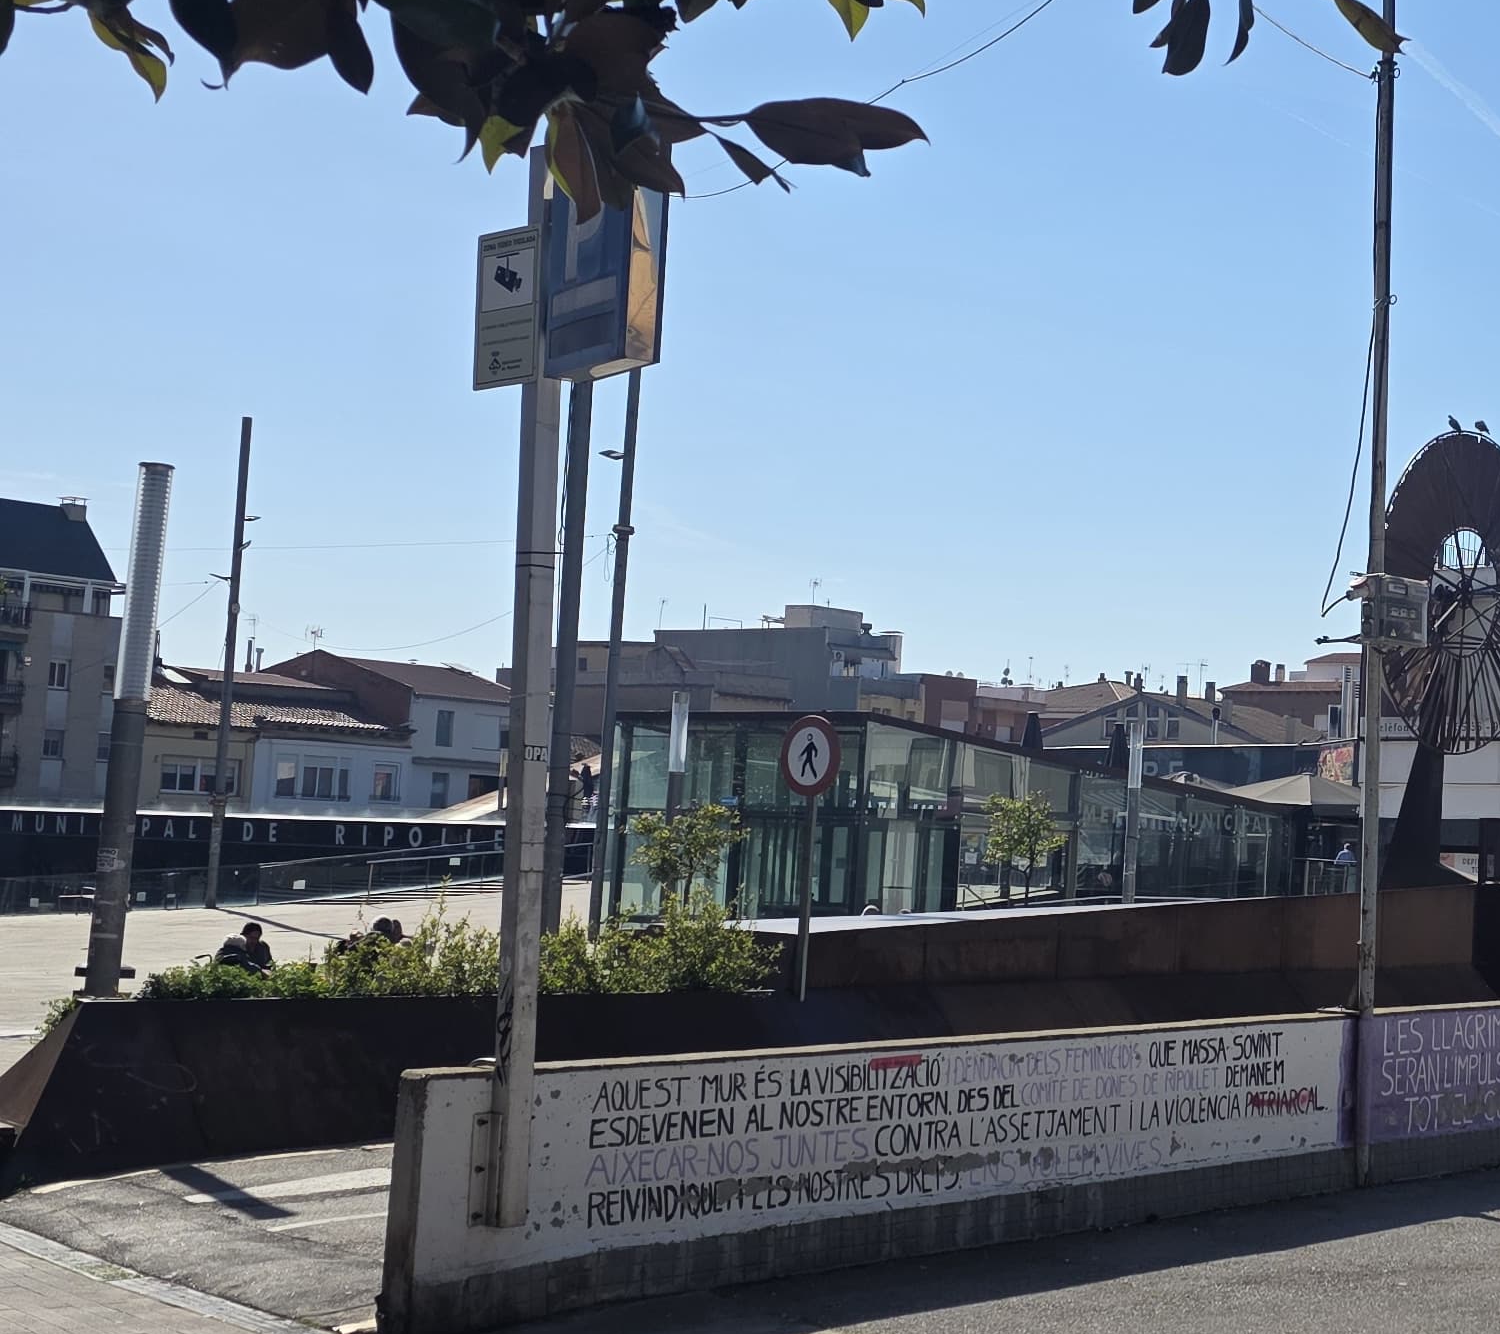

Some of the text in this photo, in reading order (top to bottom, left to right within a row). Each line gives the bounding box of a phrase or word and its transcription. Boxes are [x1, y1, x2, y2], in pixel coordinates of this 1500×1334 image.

[12, 815, 196, 838] MUNIPAL
[242, 821, 278, 842] DE
[1383, 1017, 1423, 1056] LES
[592, 1077, 690, 1113] AQUEST
[700, 1072, 747, 1104] MUR
[754, 1066, 782, 1099] ÉS
[790, 1067, 811, 1097] LA
[1149, 1040, 1176, 1068] QUE
[1182, 1037, 1227, 1066] MASSA
[1233, 1032, 1283, 1061] SOVINT
[1381, 1055, 1440, 1096] SERAN
[589, 1107, 734, 1149] ESDEVENEN
[744, 1103, 773, 1134] AL
[779, 1095, 859, 1130] NOSTRE
[867, 1091, 952, 1121] ENTORN.
[957, 1087, 989, 1113] DES
[993, 1084, 1019, 1110] DEL
[1072, 1078, 1091, 1102] DE
[1095, 1075, 1137, 1100] DONES
[1144, 1072, 1159, 1096] DE
[1225, 1061, 1285, 1089] DEMANEM
[1404, 1094, 1444, 1133] TOT
[584, 1138, 759, 1187] AIXECAR-NOS
[771, 1127, 870, 1167] JUNTES
[875, 1120, 961, 1157] CONTRA
[970, 1104, 1121, 1147] L'ASSETJAMENT
[1141, 1103, 1159, 1131] LA
[799, 1168, 890, 1205] NOSTRES
[1102, 1136, 1162, 1173] VIVES
